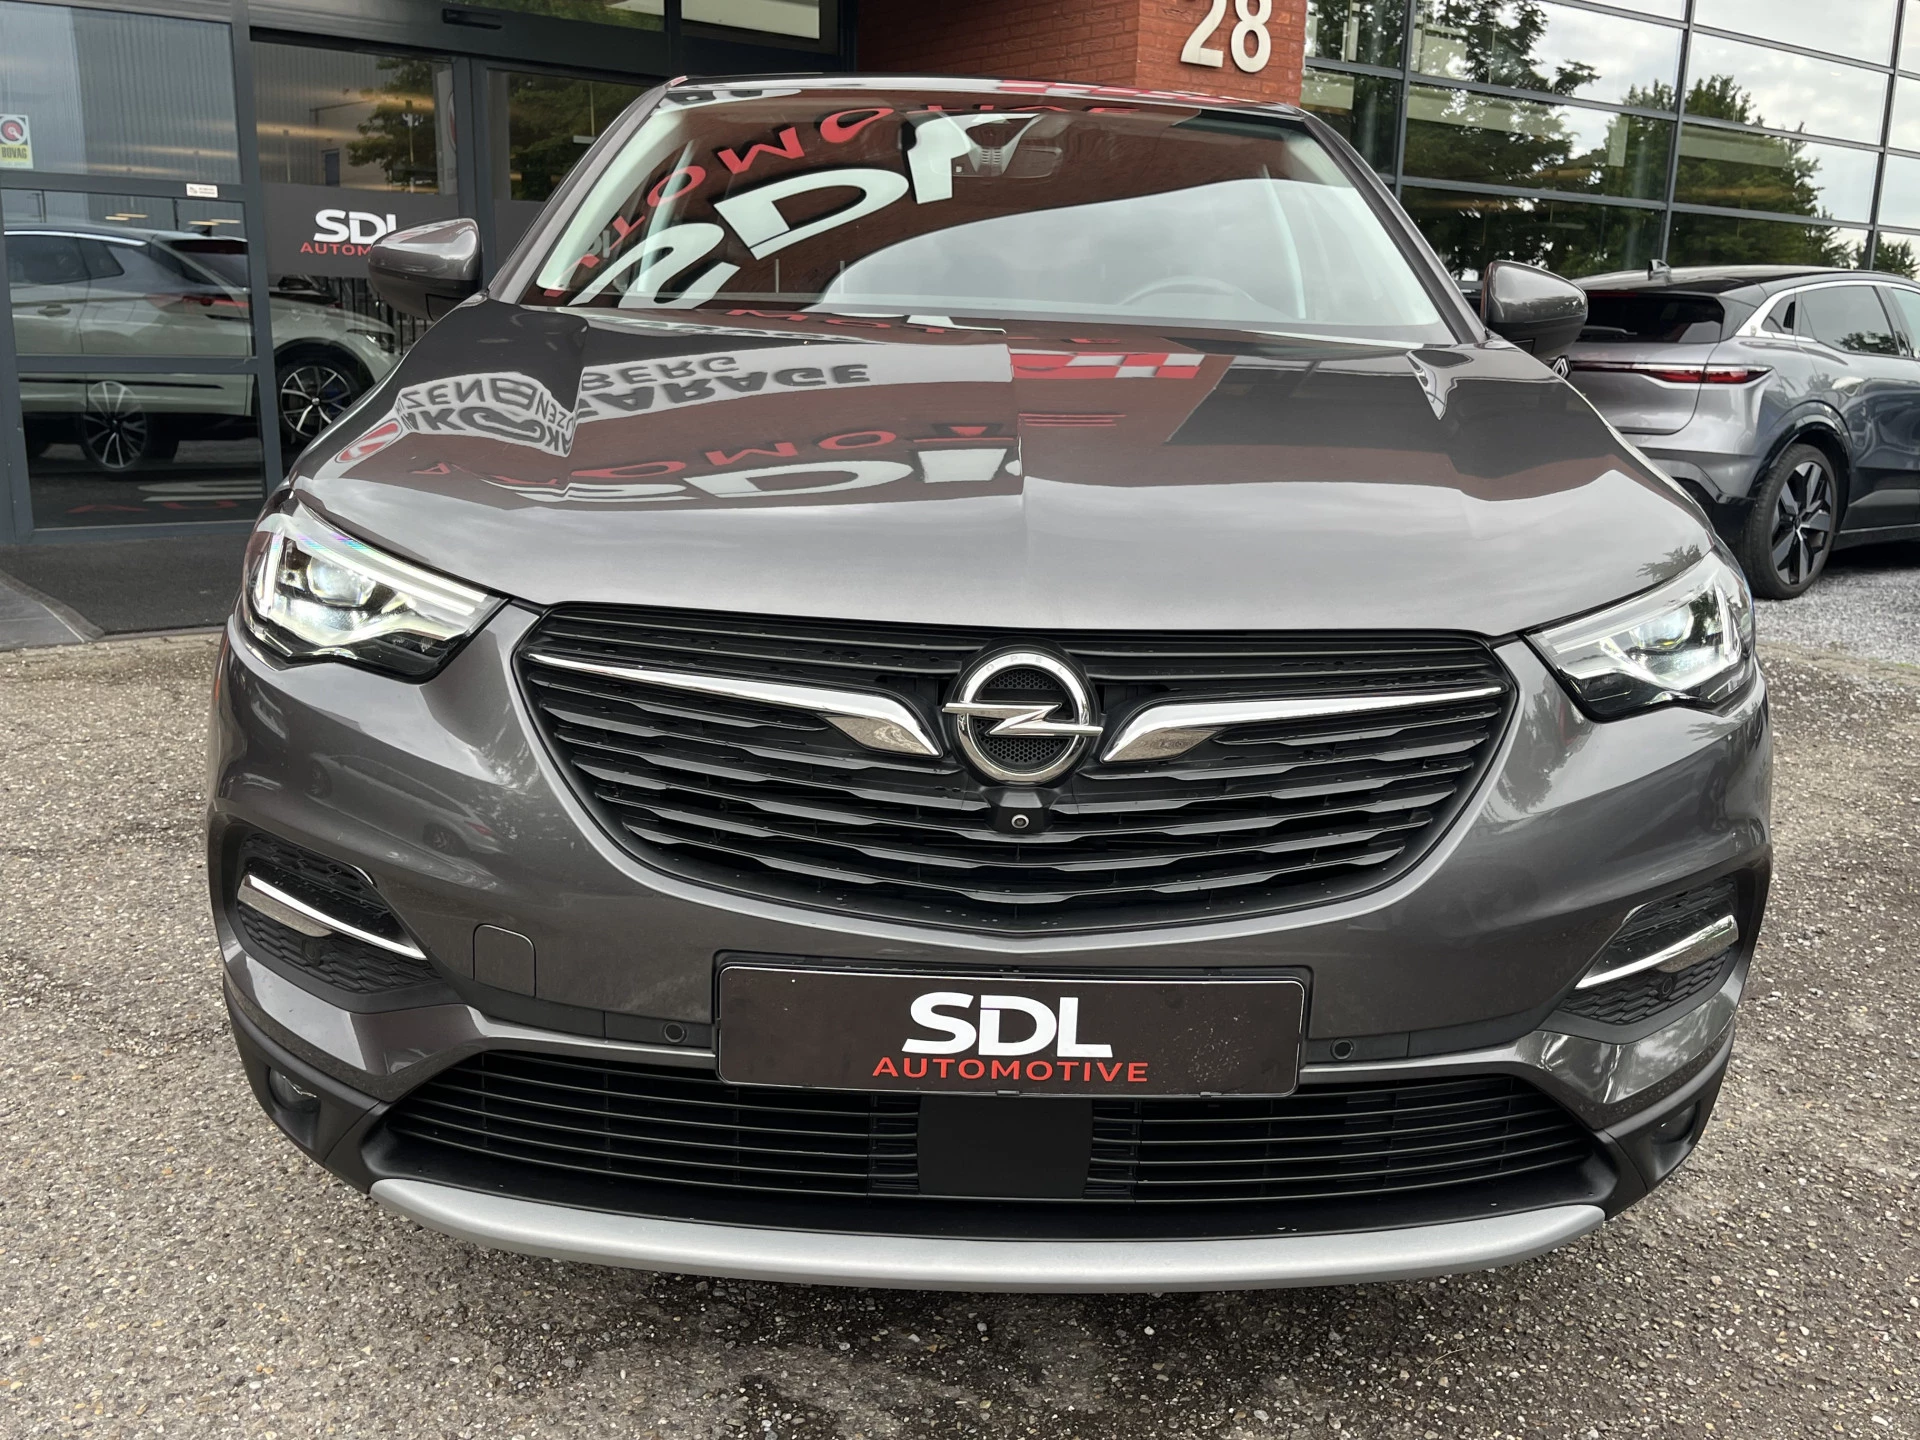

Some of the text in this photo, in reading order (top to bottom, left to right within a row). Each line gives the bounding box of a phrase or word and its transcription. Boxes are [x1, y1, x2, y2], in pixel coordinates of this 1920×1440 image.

[1180, 0, 1272, 73] 28
[300, 241, 372, 256] AUTOM
[986, 654, 1063, 675] OPEL
[901, 991, 1113, 1058] SDL
[872, 1056, 1149, 1083] AUTOMOTIVE
